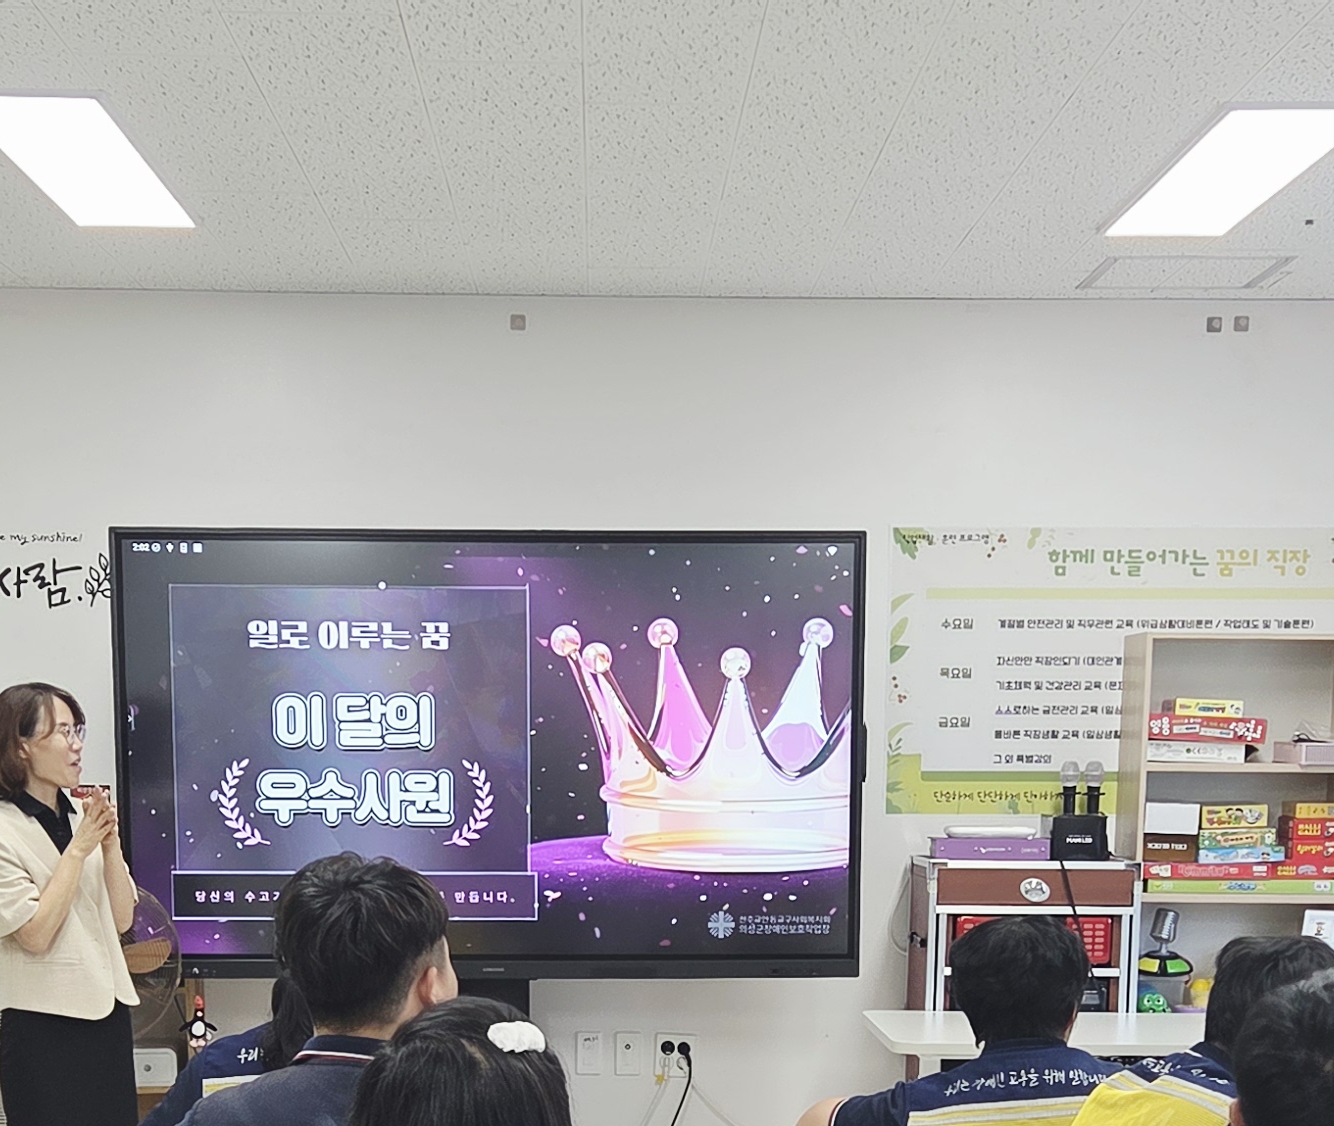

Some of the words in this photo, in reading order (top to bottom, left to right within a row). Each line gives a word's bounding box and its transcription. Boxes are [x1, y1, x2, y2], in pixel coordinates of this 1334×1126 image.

[10, 533, 29, 546] my
[31, 531, 83, 543] sunshine!
[959, 533, 990, 545] 프로그램
[1047, 548, 1095, 577] 함께
[1102, 548, 1210, 578] 만들어가는
[1216, 548, 1258, 577] 꿈의
[1266, 548, 1312, 577] 직장
[941, 618, 974, 630] 수요일
[1027, 618, 1064, 629] 안전관리
[1066, 618, 1075, 630] 및
[1077, 619, 1114, 629] 직무관련
[1116, 618, 1134, 629] 교육
[247, 619, 311, 650] 일로
[317, 620, 412, 650] 이루는
[419, 621, 451, 650] 꿈
[996, 656, 1032, 666] 자신만만
[939, 667, 972, 679] 목요일
[995, 680, 1032, 691] 기초체력
[1034, 680, 1043, 691] 및
[1045, 680, 1081, 691] 건강관리
[1083, 681, 1102, 691] 교육
[1042, 705, 1079, 716] 금전관리
[1080, 706, 1098, 716] 교육
[272, 692, 327, 750] 이
[333, 692, 436, 750] 달의
[938, 717, 970, 728] 금요일
[994, 730, 1021, 740] 올바른
[1023, 730, 1060, 740] 직장생활
[1062, 730, 1079, 740] 교육
[993, 754, 1002, 764] 그
[255, 767, 455, 827] 우수사원
[195, 890, 235, 903] 당신의
